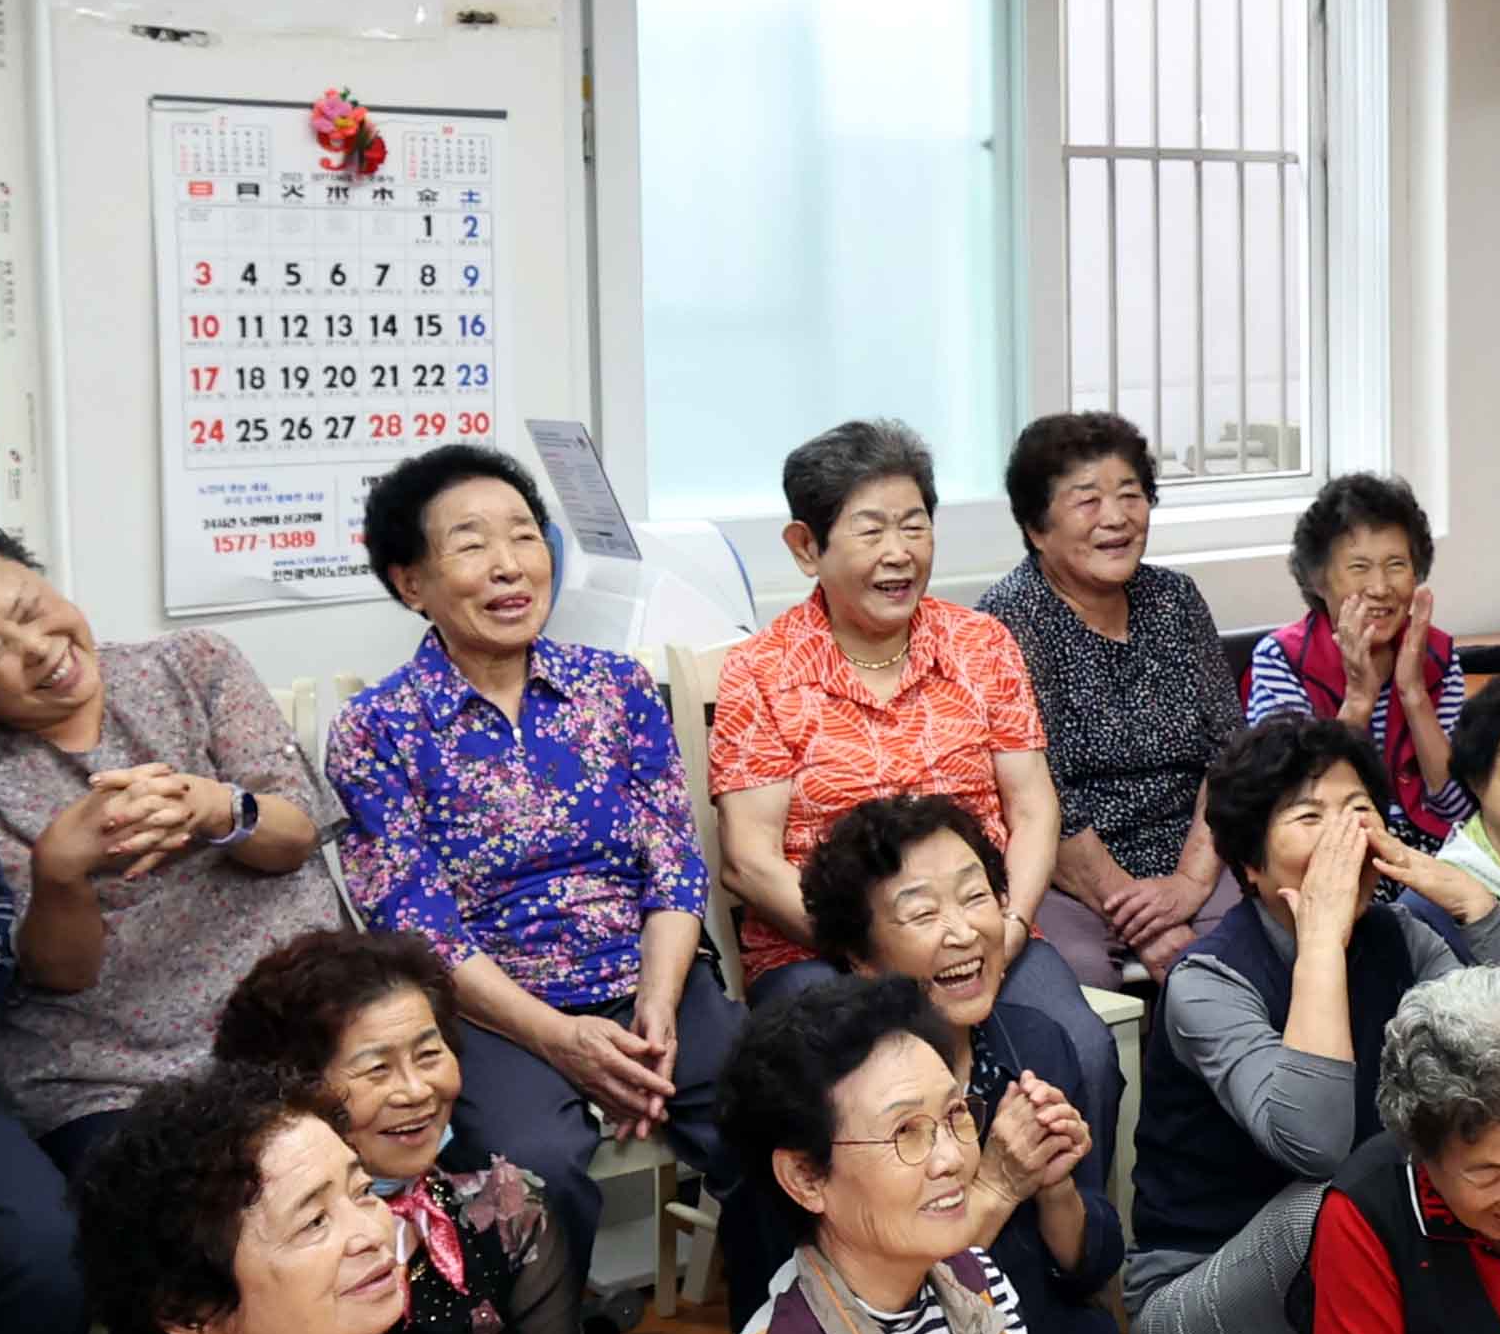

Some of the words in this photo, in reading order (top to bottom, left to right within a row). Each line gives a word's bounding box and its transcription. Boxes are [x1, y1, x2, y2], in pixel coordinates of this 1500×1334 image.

[281, 184, 305, 199] 火
[371, 186, 395, 202] 木
[417, 188, 439, 203] 金
[459, 189, 482, 204] 土
[422, 213, 433, 238] 1
[462, 214, 480, 239] 2
[195, 261, 213, 287] 3
[240, 261, 259, 287] 4
[284, 262, 303, 287] 5
[329, 262, 348, 288] 6
[374, 262, 391, 288] 7
[419, 263, 437, 288] 8
[462, 264, 480, 288] 9
[189, 314, 221, 340] 10
[237, 314, 264, 340] 11
[280, 313, 309, 339] 12
[324, 313, 354, 339] 13
[369, 313, 399, 339] 14
[413, 313, 443, 338] 15
[457, 314, 487, 338] 16
[190, 366, 220, 392] 17
[235, 366, 266, 391] 18
[279, 365, 311, 390] 19
[322, 364, 357, 390] 20
[369, 364, 399, 389] 21
[411, 363, 446, 388] 22
[456, 363, 489, 387] 23
[189, 418, 224, 445] 24
[235, 417, 268, 444] 25
[280, 416, 313, 442] 26
[323, 414, 357, 440] 27
[368, 413, 403, 438] 28
[413, 412, 447, 437] 29
[457, 411, 491, 436] 30
[213, 530, 316, 553] 1577-1389
